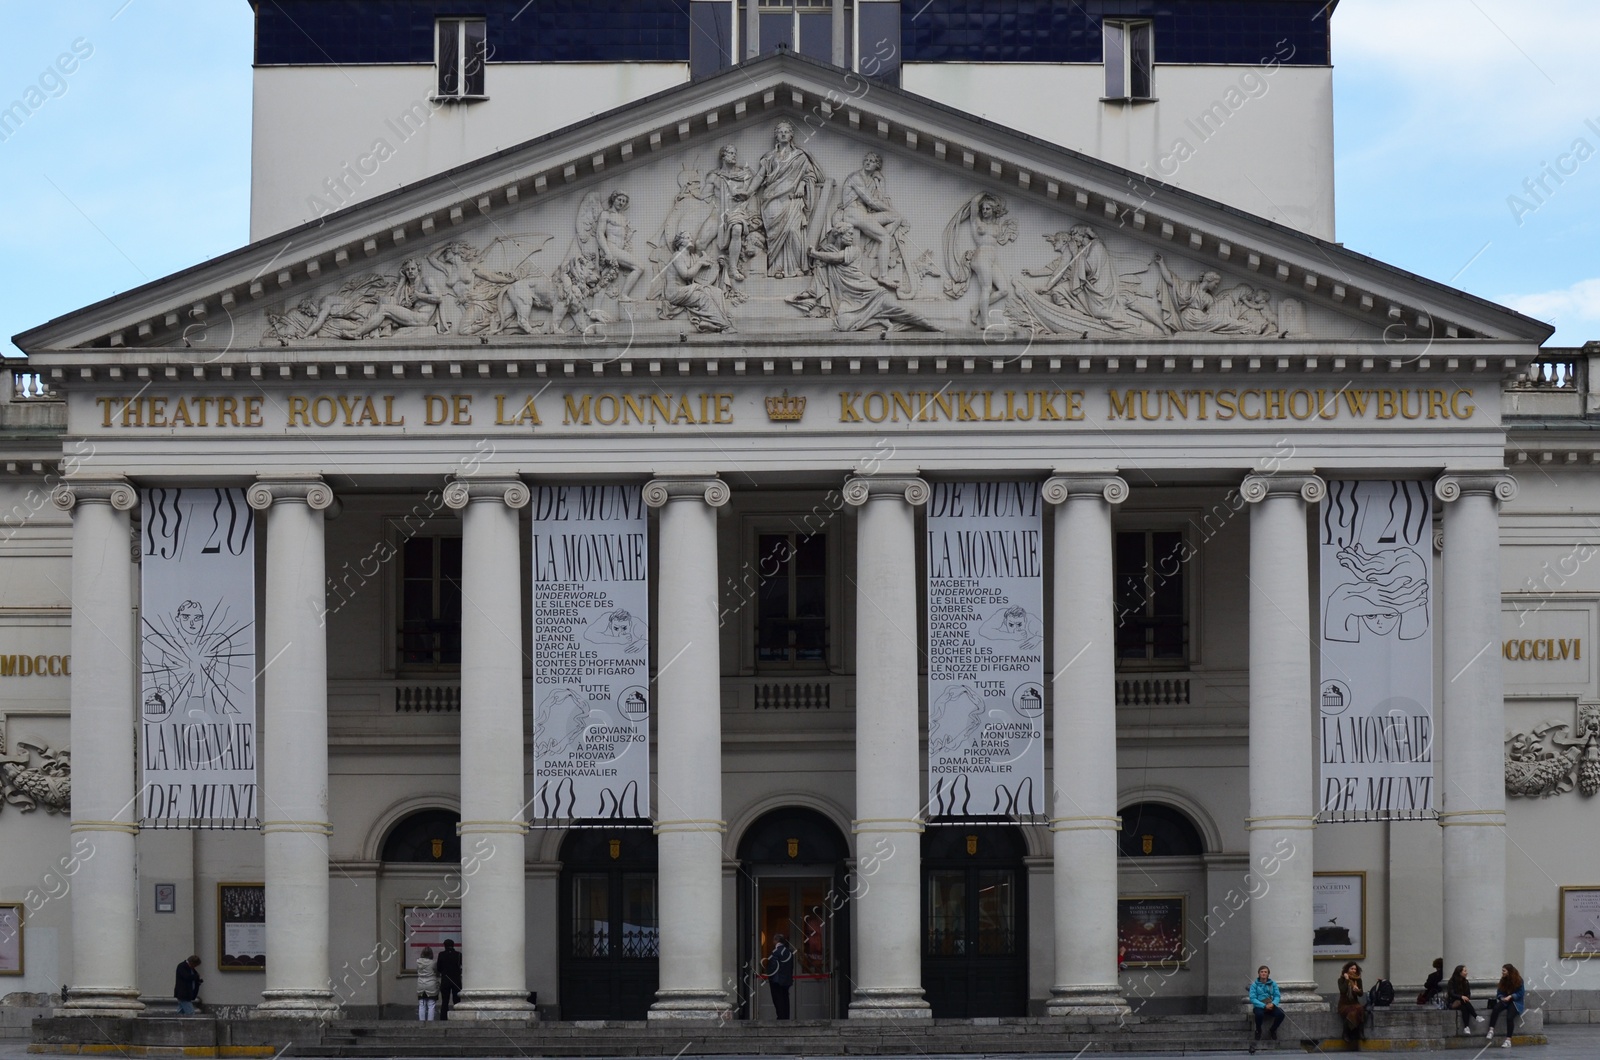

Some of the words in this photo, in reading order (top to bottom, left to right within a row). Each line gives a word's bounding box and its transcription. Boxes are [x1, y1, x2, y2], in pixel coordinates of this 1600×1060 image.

[96, 396, 264, 427] THEATRE
[286, 395, 404, 427] ROYAL
[424, 394, 472, 425] DE
[494, 394, 542, 425] LA
[562, 393, 734, 425] MONNAIE
[838, 389, 1086, 423] KONINKLIJKE
[1107, 388, 1475, 421] MUNTSCHOUWBURG
[534, 534, 558, 582] LA
[562, 534, 645, 582] MONNAIE
[929, 530, 953, 578] LA
[957, 530, 1040, 578] MONNAIE
[930, 580, 979, 588] MACBETH
[930, 588, 1002, 596] UNDERWORLD
[536, 600, 546, 608] LE
[550, 600, 591, 608] SILENCE
[594, 600, 614, 608] DES
[930, 622, 967, 630] D'ARCO
[536, 634, 574, 642] JEANNE
[1502, 638, 1581, 661] CCCLVI
[931, 664, 942, 672] LE
[946, 664, 978, 672] NOZZE
[981, 664, 990, 672] DI
[993, 664, 1030, 672] FIGARO
[144, 723, 169, 770] LA
[172, 723, 254, 770] MONNAIE
[1321, 716, 1346, 763] LA
[1349, 716, 1431, 763] MONNAIE
